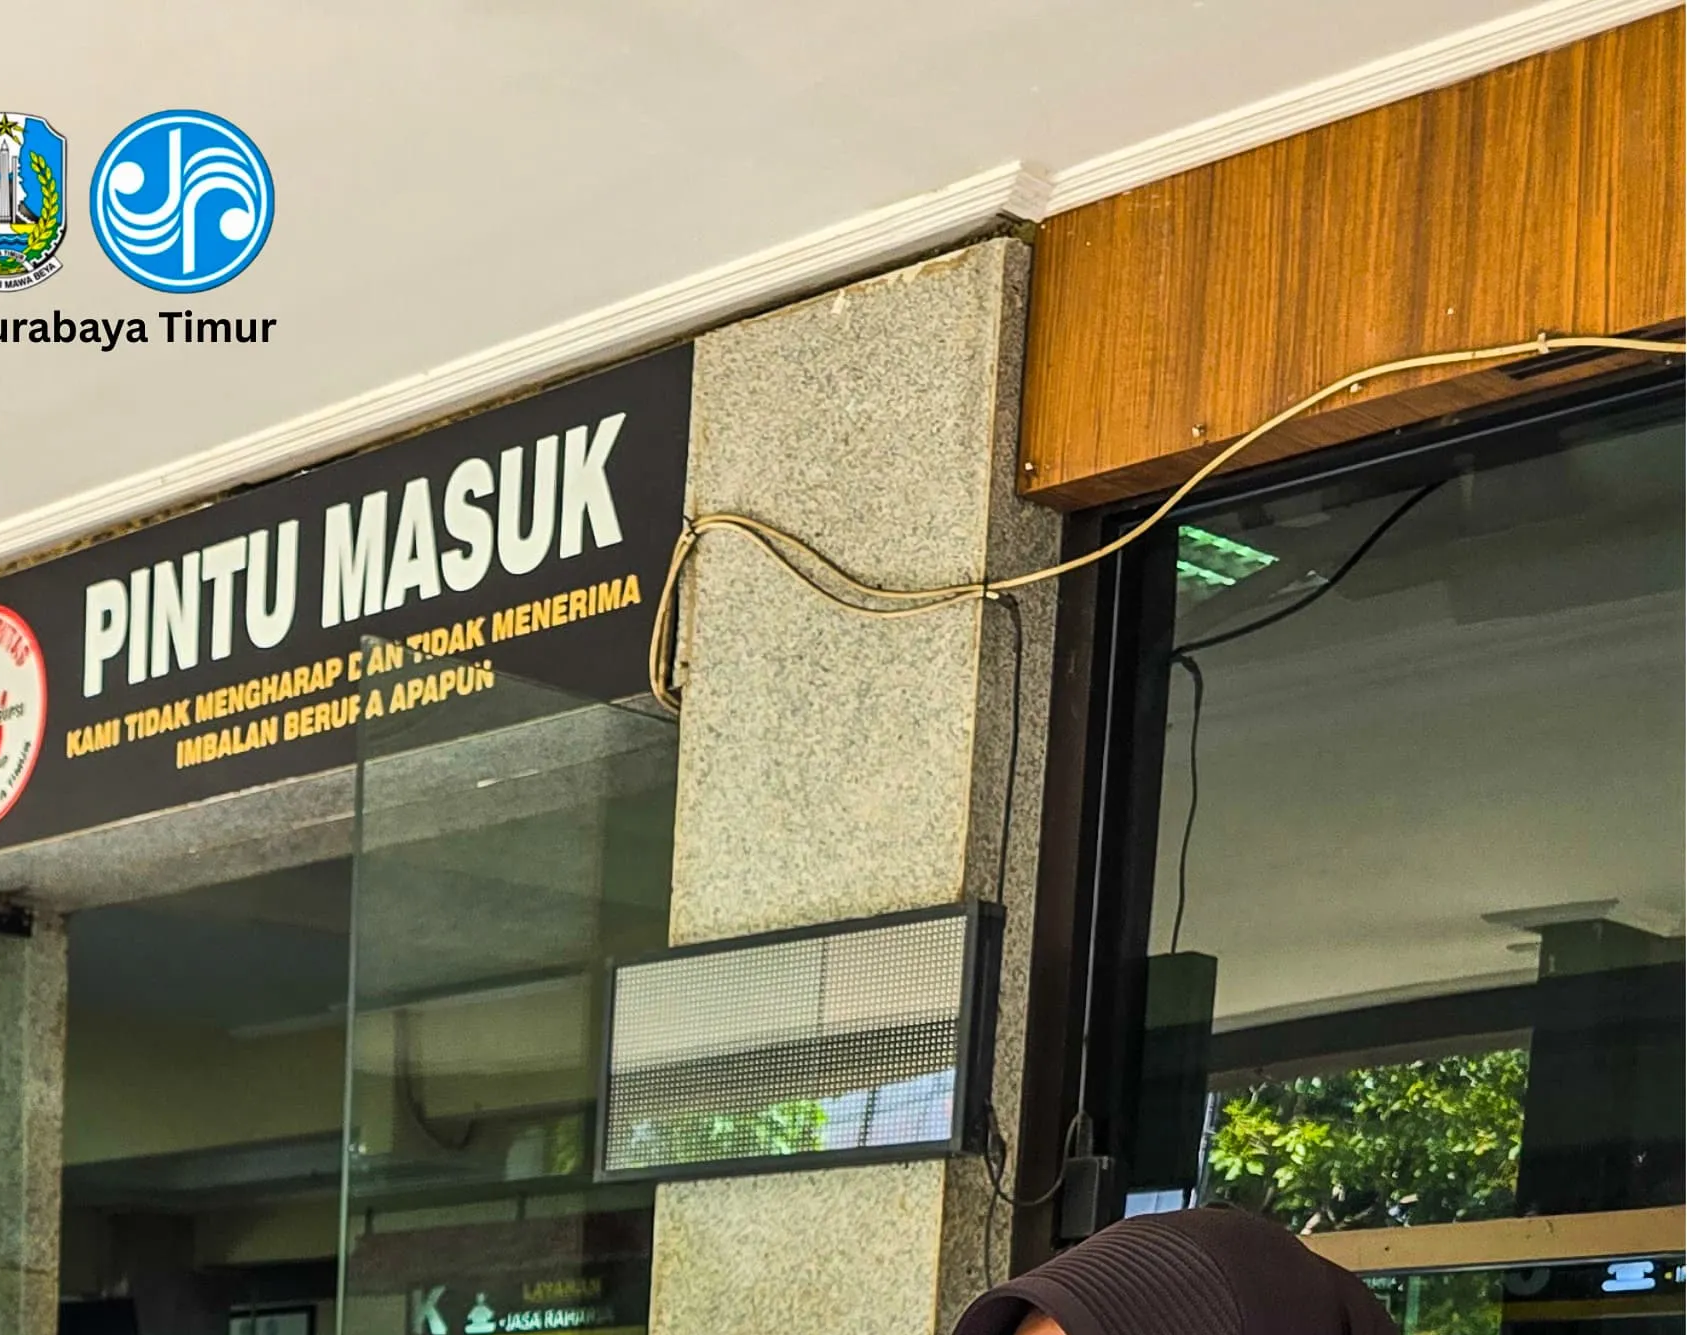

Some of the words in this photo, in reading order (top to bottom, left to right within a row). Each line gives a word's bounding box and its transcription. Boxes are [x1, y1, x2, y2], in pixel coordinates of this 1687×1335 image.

[82, 518, 301, 698] PINTU
[321, 411, 628, 629] MASUK
[66, 719, 121, 758] KAMI
[124, 698, 192, 742] TIDAK
[194, 657, 344, 724] MENGHARAP
[406, 615, 486, 664] TIDAK
[491, 573, 642, 643] MENERIMA
[175, 715, 280, 770] IMBALAN
[388, 658, 496, 714] APAPUN
